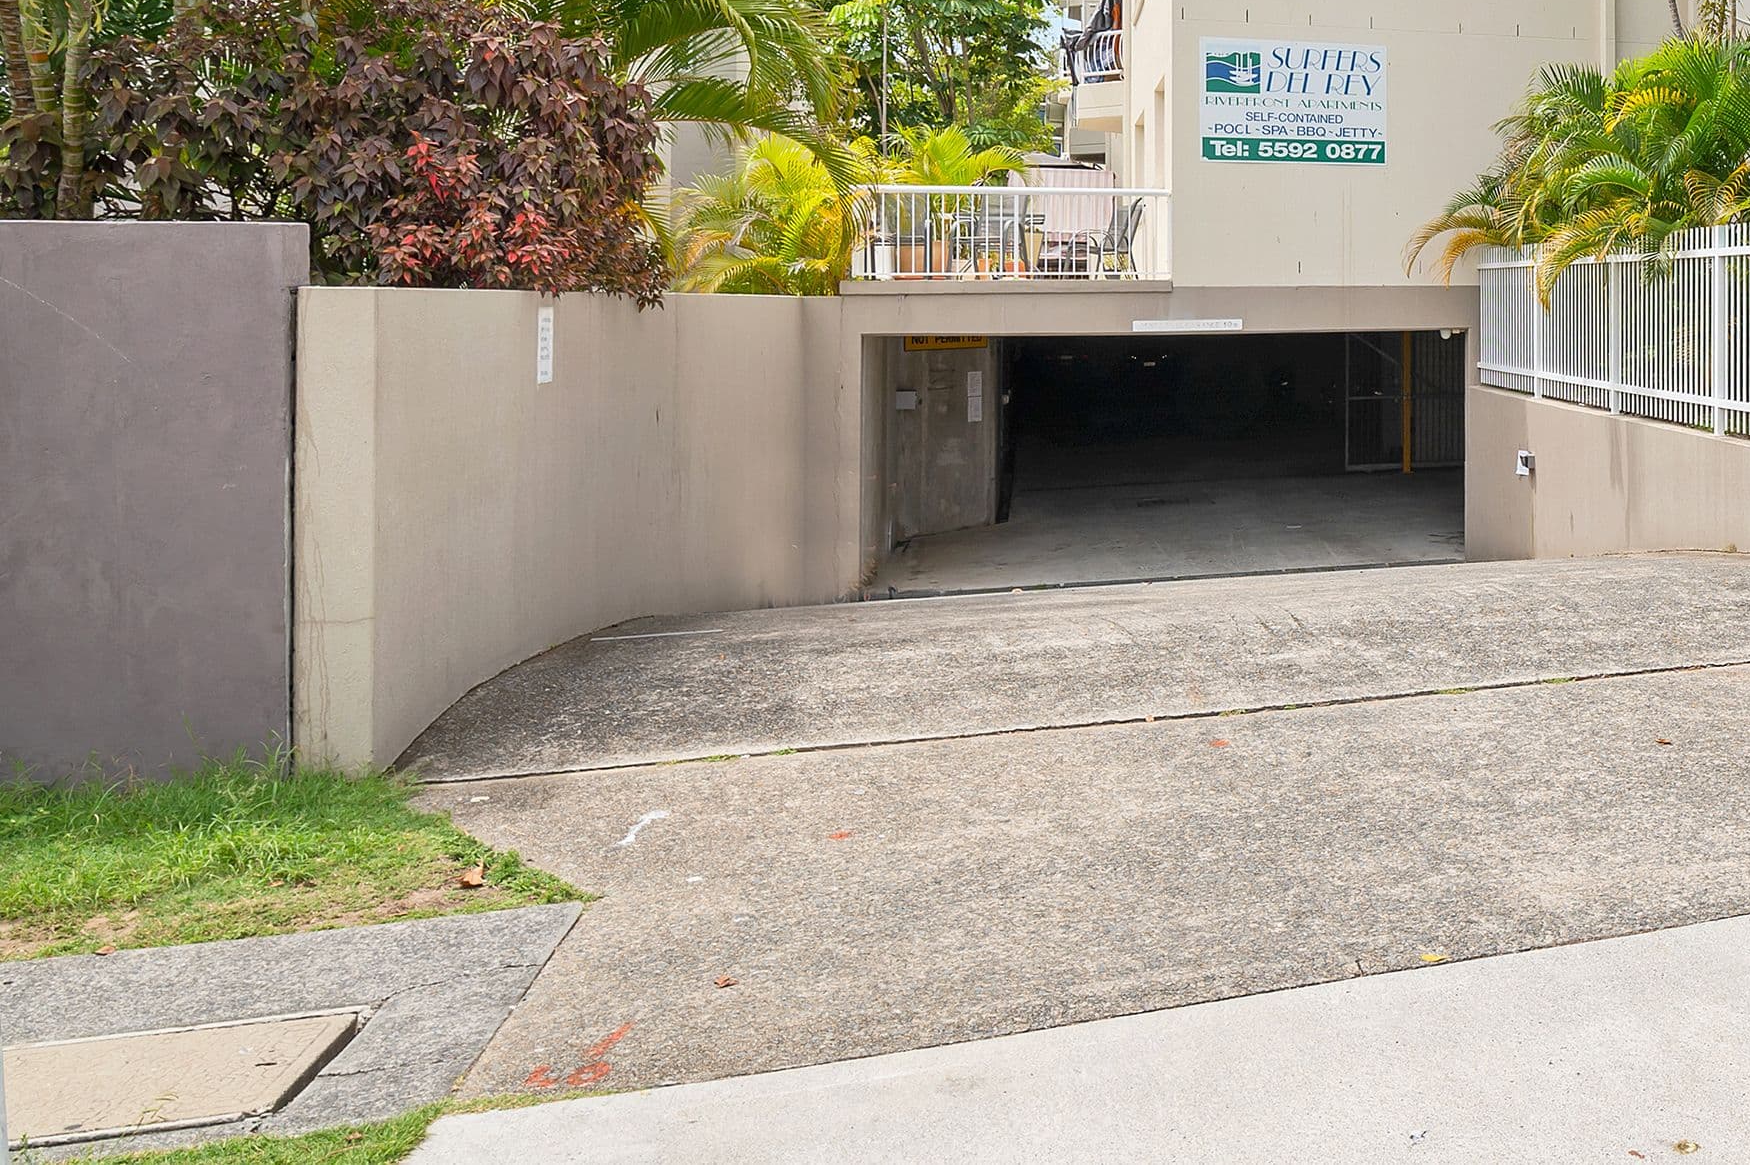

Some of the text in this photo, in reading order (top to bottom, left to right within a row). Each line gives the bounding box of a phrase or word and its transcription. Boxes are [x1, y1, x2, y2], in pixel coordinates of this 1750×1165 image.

[1268, 47, 1382, 73] SURFERS
[1266, 71, 1382, 96] DEL REY
[1205, 96, 1382, 111] RIVERFRONT APARTMENTS
[1245, 112, 1343, 124] SELF-CONTAINED
[1209, 140, 1382, 160] Tel: 5592 0877
